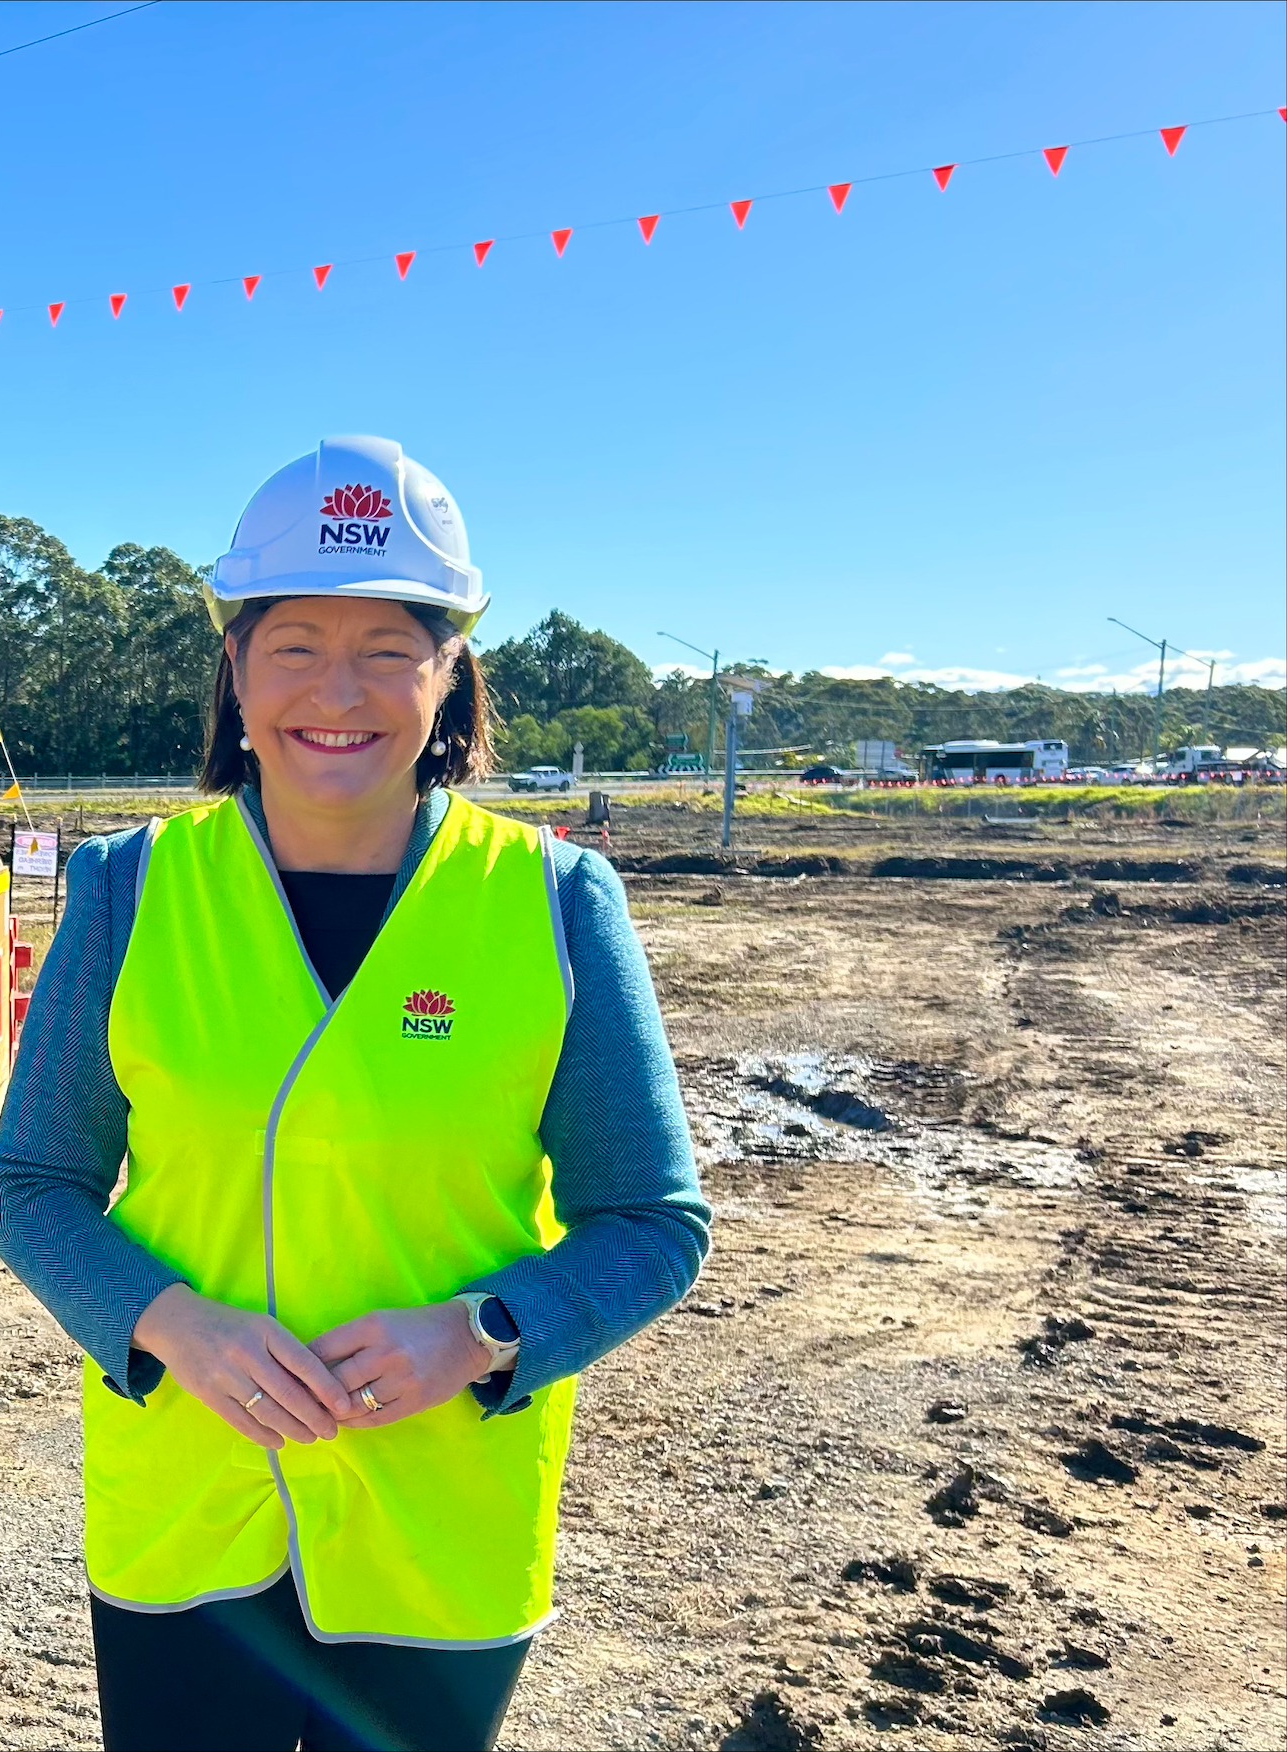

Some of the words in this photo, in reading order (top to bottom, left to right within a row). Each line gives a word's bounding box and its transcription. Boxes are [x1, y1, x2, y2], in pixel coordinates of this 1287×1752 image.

[320, 523, 391, 547] NSW
[318, 545, 387, 557] GOVERNMENT
[402, 1016, 453, 1034] NSW
[402, 1032, 451, 1040] GOVERNMENT
